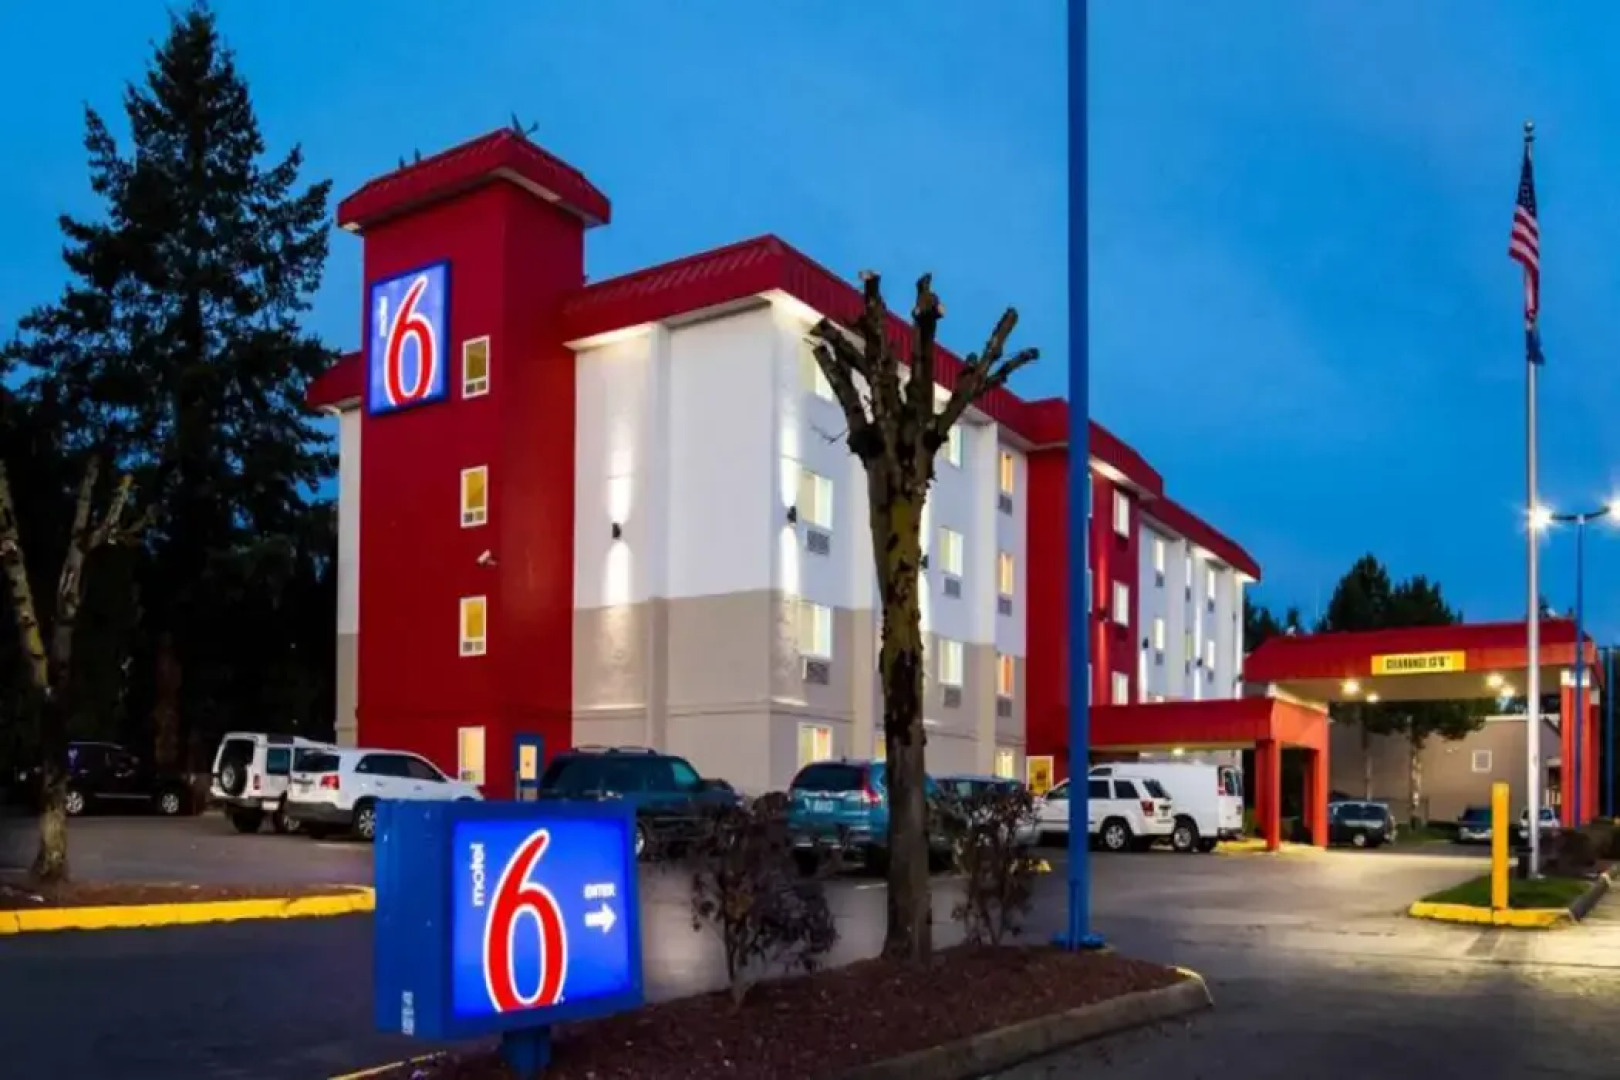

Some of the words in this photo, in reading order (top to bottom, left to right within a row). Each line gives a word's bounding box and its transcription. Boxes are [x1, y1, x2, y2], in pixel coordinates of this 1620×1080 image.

[384, 275, 437, 406] 6
[469, 843, 485, 907] motel
[482, 828, 569, 1013] 6
